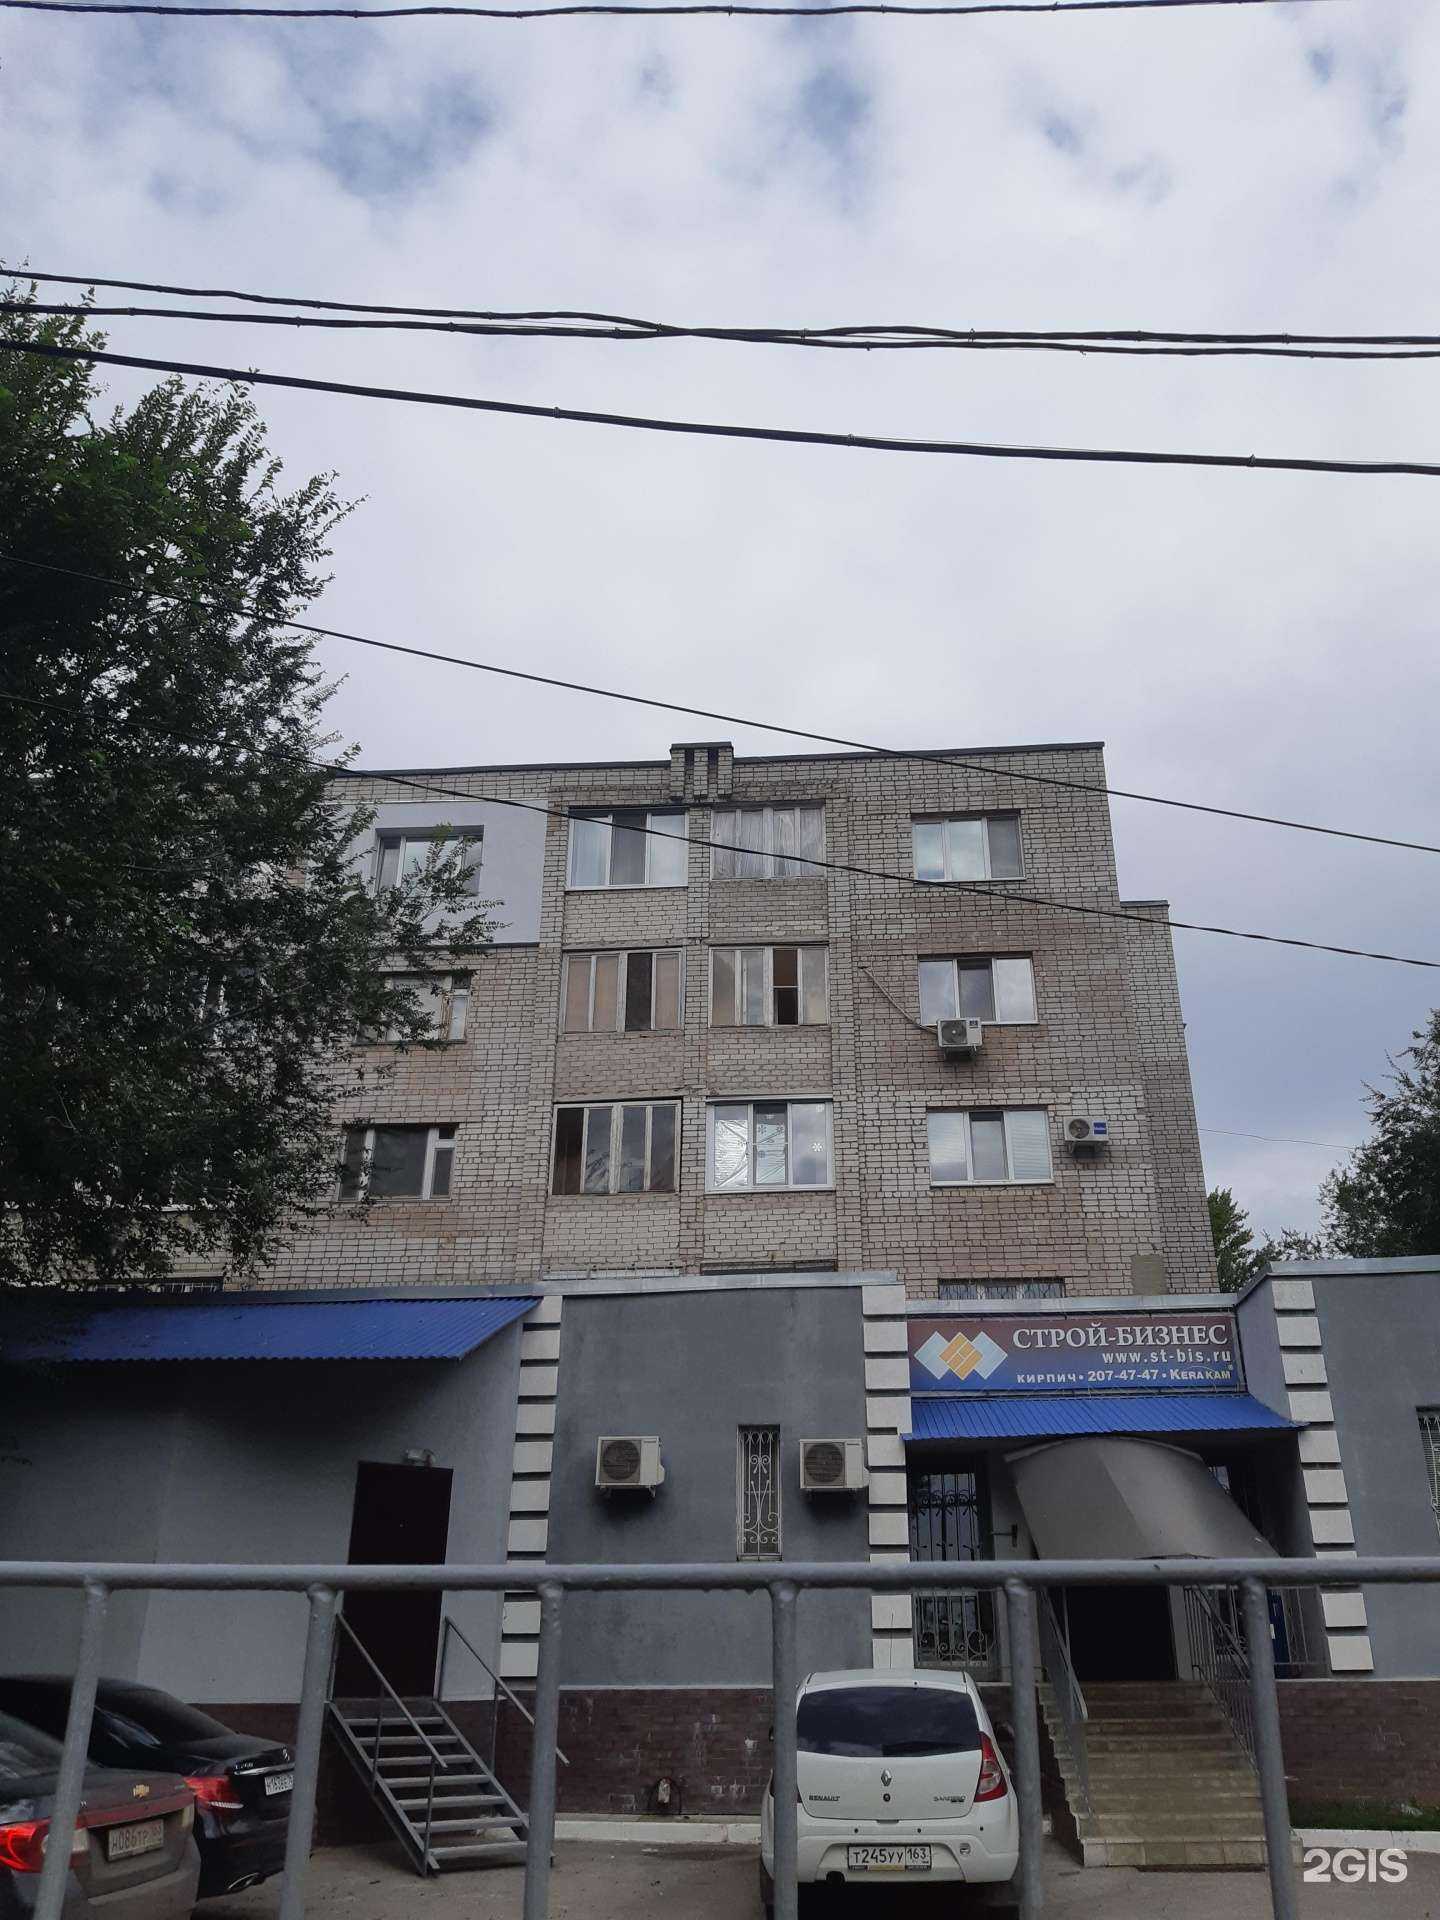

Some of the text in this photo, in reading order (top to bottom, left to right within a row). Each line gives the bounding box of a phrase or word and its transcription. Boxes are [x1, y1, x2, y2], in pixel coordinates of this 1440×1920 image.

[1012, 1322, 1228, 1349] СТРОЙ-БИЗНЕС
[1102, 1349, 1231, 1363] www.st-bis.ru
[1087, 1369, 1159, 1382] 207-47-47
